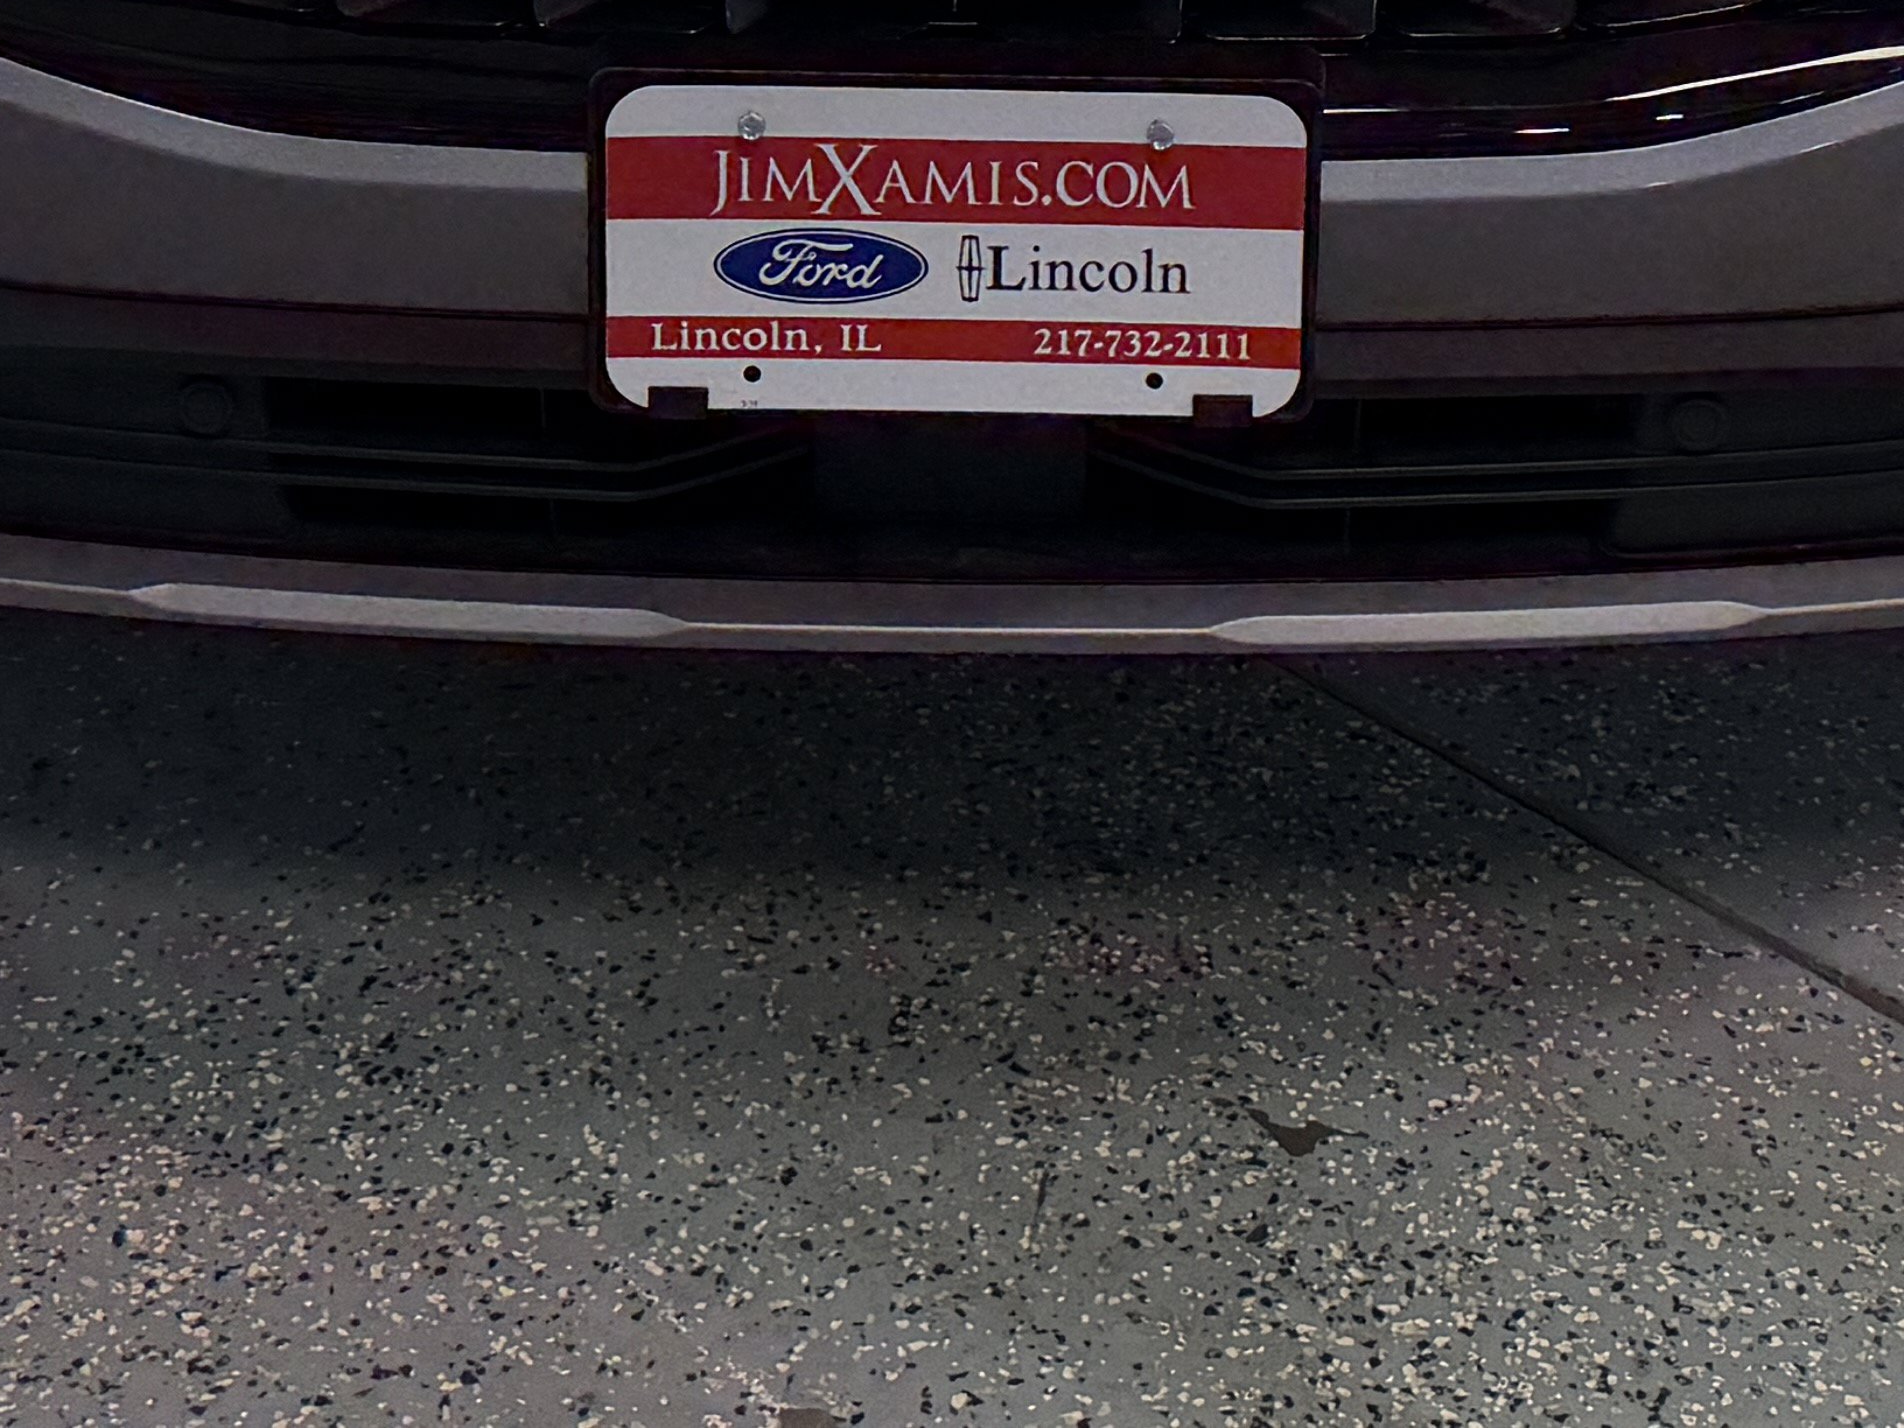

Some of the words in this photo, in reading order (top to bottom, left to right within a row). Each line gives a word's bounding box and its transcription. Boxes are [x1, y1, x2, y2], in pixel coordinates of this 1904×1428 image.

[710, 143, 1195, 216] JIMXAMIS.COM
[758, 240, 882, 290] Ford
[986, 245, 1191, 295] Lincoln
[651, 320, 822, 354] Lincoln,
[840, 324, 882, 352] IL
[1033, 328, 1251, 360] 217-732-2111
